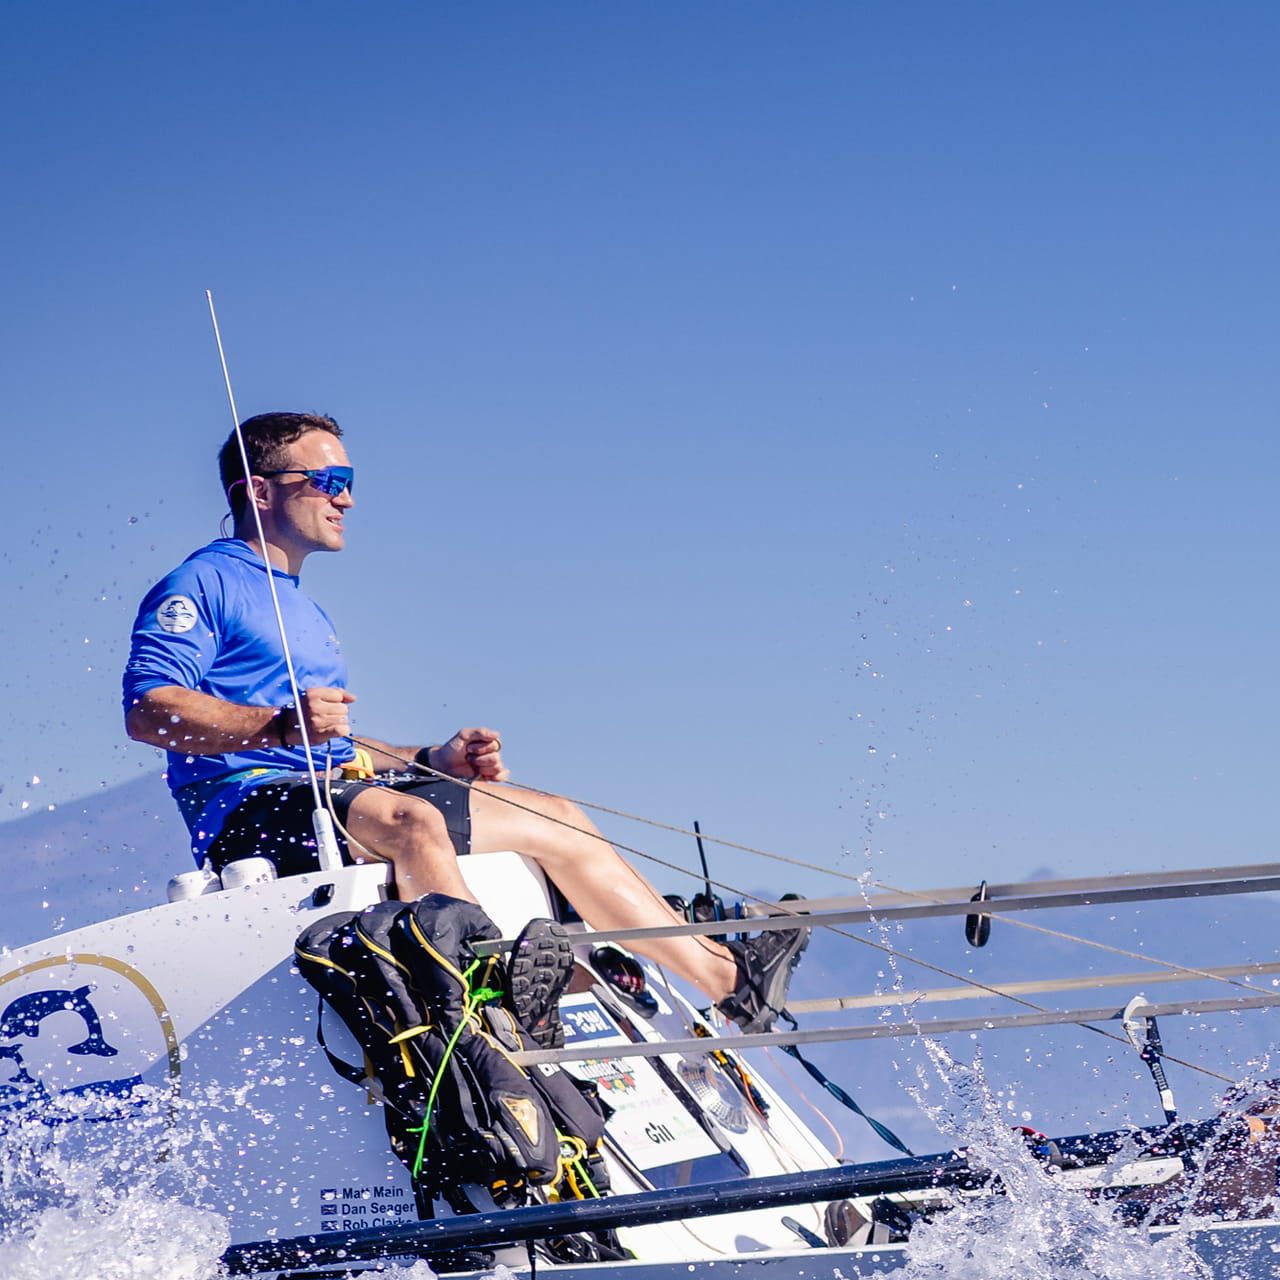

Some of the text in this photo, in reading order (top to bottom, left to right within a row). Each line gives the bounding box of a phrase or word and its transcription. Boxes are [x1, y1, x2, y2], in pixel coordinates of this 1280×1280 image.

[645, 1122, 675, 1144] Gill
[373, 1186, 404, 1198] Main
[342, 1202, 415, 1216] Dan Seager
[342, 1219, 369, 1231] Rob
